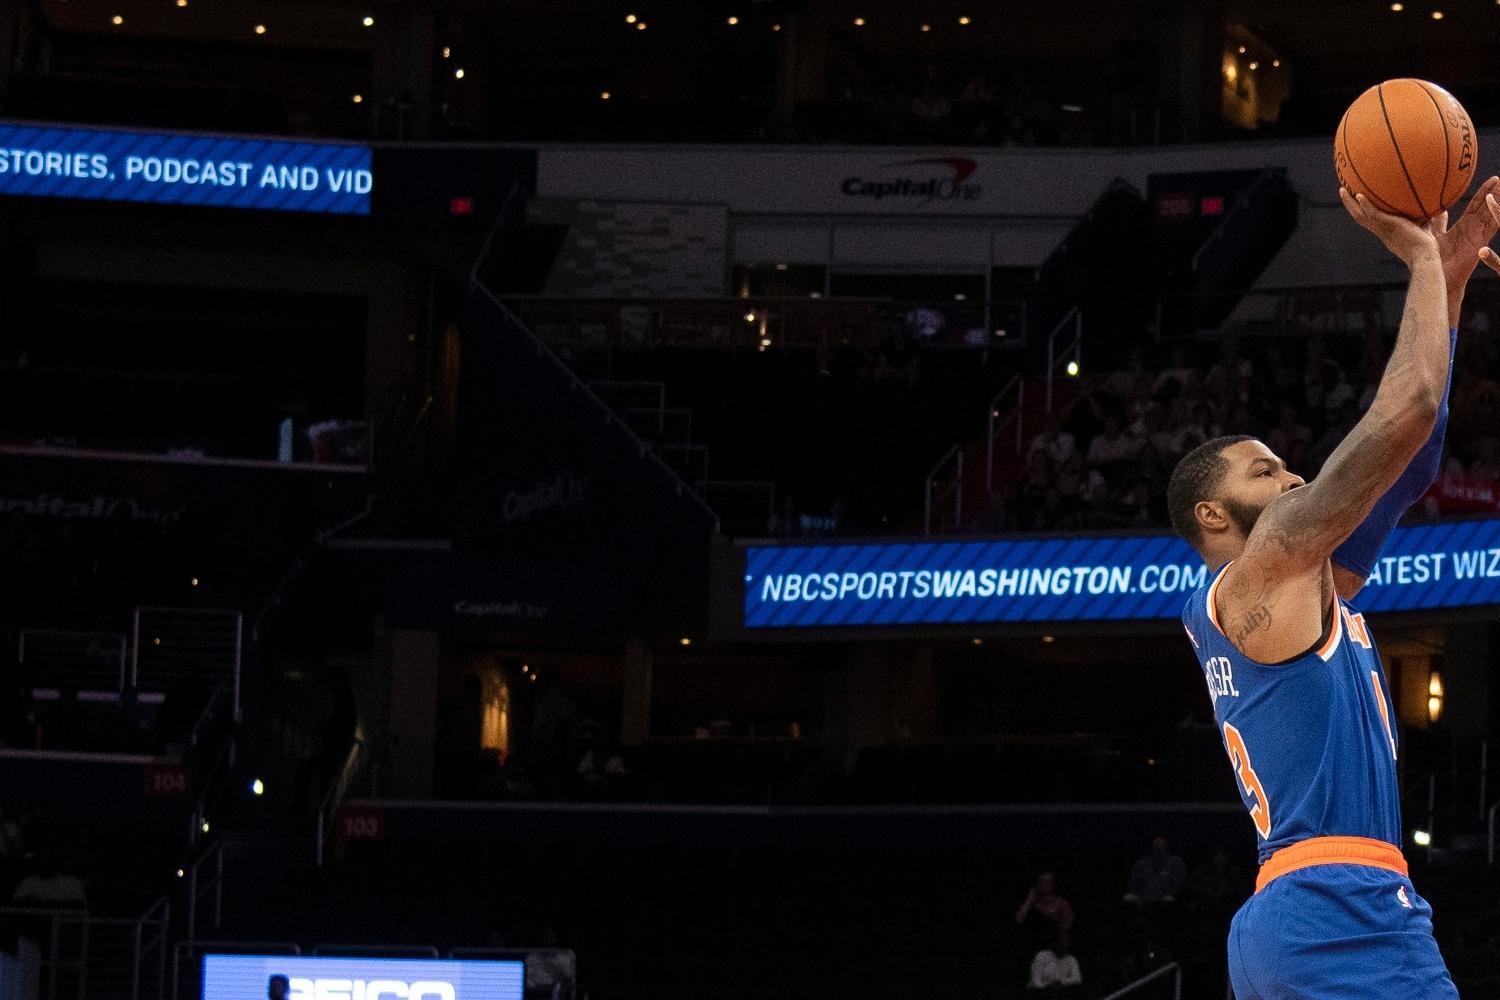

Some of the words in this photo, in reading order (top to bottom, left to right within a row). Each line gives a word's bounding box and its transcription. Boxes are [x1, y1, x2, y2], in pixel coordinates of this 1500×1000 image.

[126, 156, 254, 187] PODCAST
[260, 163, 319, 192] AND
[326, 167, 373, 195] VID
[760, 563, 1208, 602] NBCSPORTSWASHINGTON.COM
